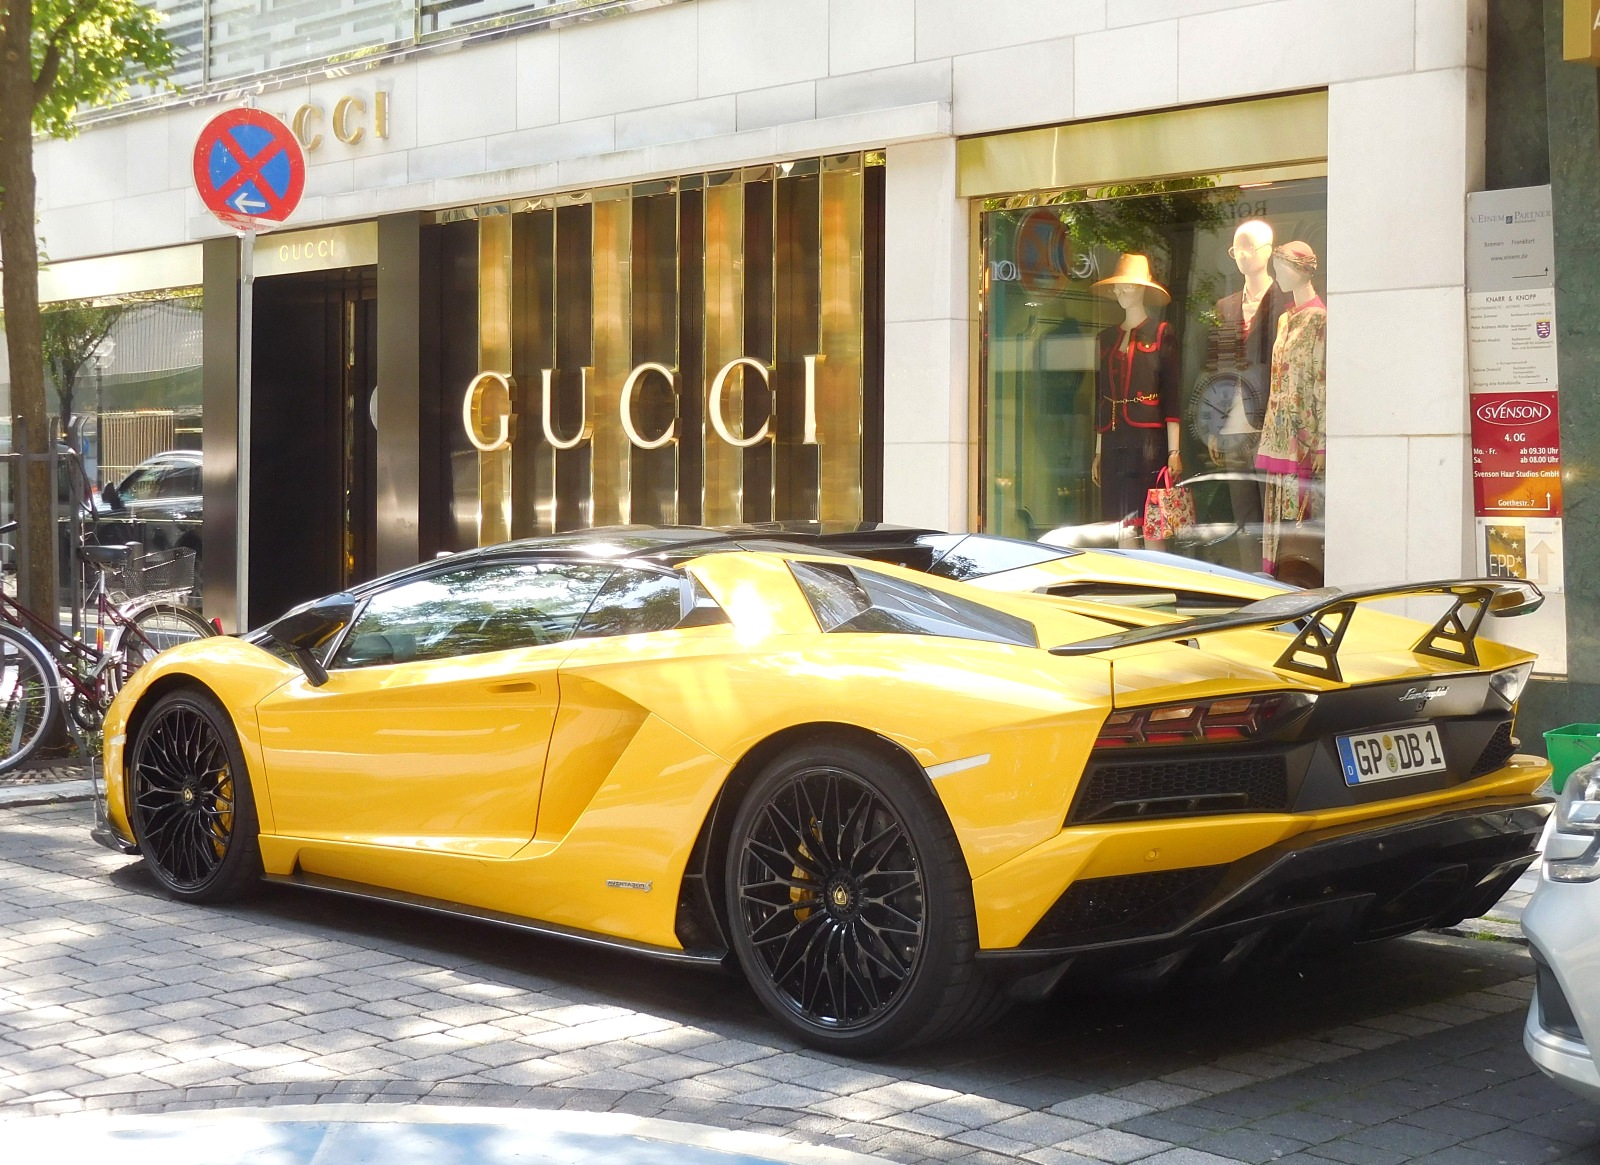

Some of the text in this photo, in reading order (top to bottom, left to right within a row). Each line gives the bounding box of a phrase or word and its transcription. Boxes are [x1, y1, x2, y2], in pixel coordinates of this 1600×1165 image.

[276, 91, 388, 152] CCI
[280, 239, 334, 262] GUCCI
[1516, 293, 1537, 301] KNOPP
[463, 353, 826, 452] GUCCI
[1485, 406, 1542, 419] SVENSON
[1504, 433, 1526, 441] 4. OG
[1474, 470, 1499, 478] Svenson
[1500, 470, 1515, 478] Haar
[1490, 554, 1516, 577] EPP
[1354, 730, 1442, 776] GP DB 1
[1347, 765, 1354, 776] D
